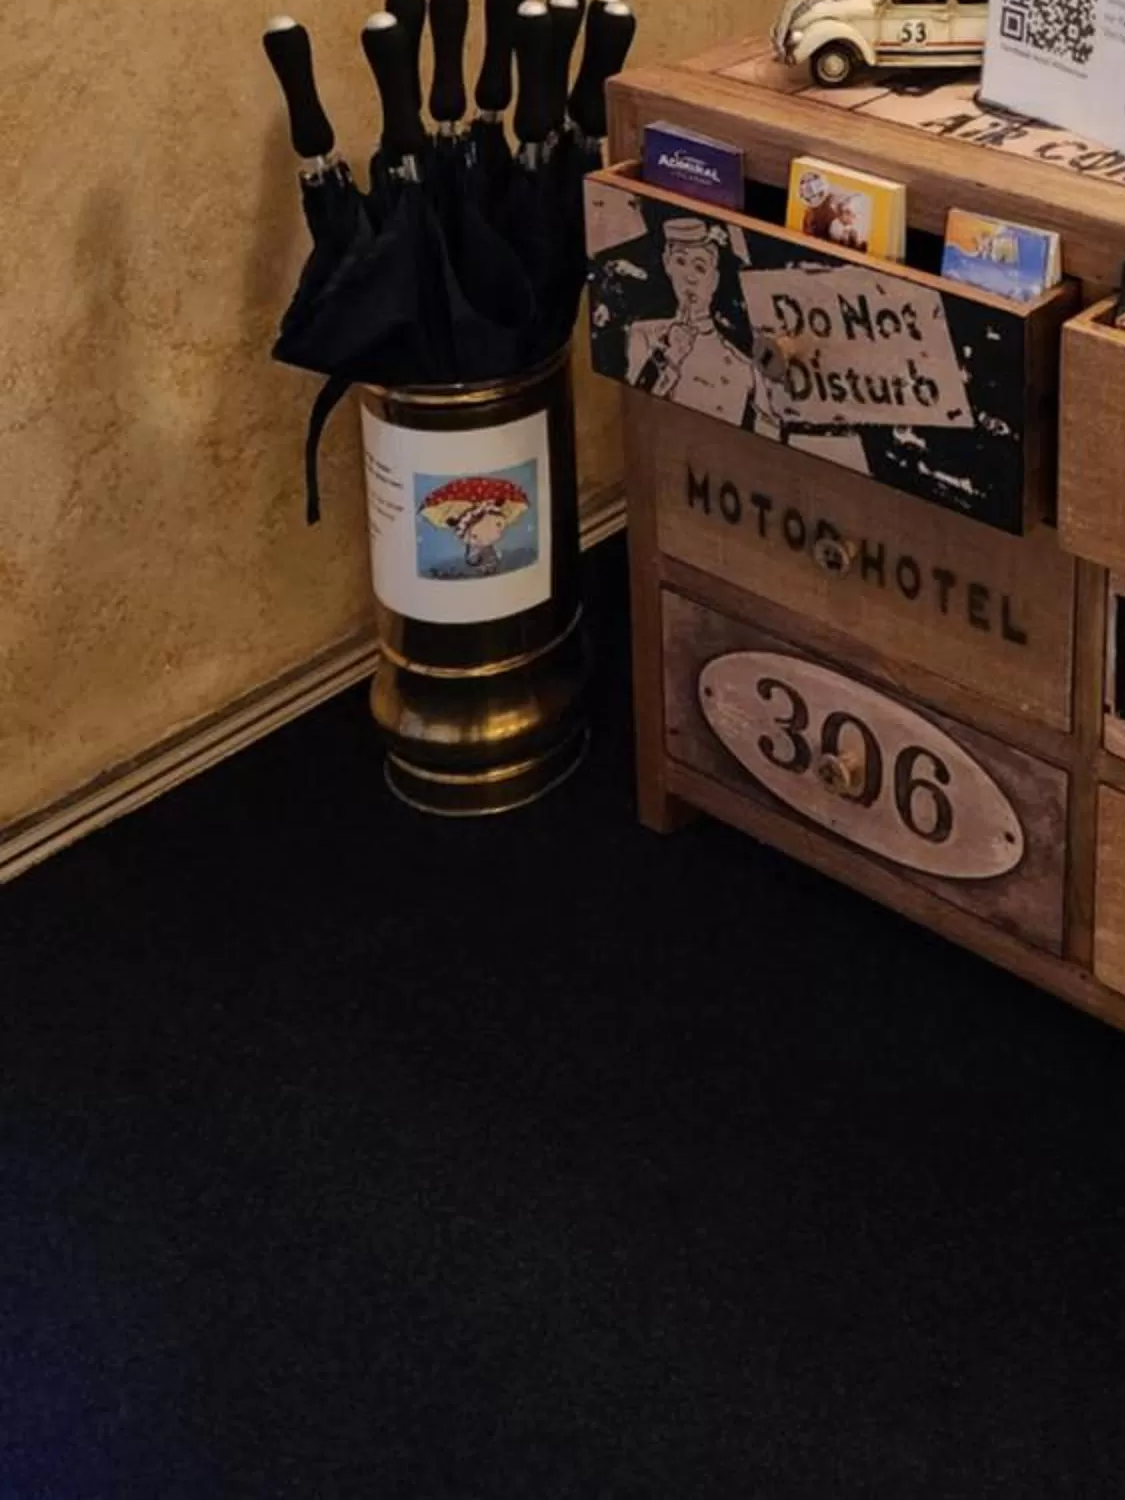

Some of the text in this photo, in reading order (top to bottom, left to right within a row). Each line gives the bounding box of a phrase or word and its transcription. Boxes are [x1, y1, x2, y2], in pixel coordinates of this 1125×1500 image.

[900, 21, 928, 43] 53
[919, 113, 1029, 148] AIR
[771, 293, 922, 341] Do Not
[785, 349, 940, 407] Disturb
[860, 538, 1029, 646] HOTEL
[756, 676, 955, 844] 306
